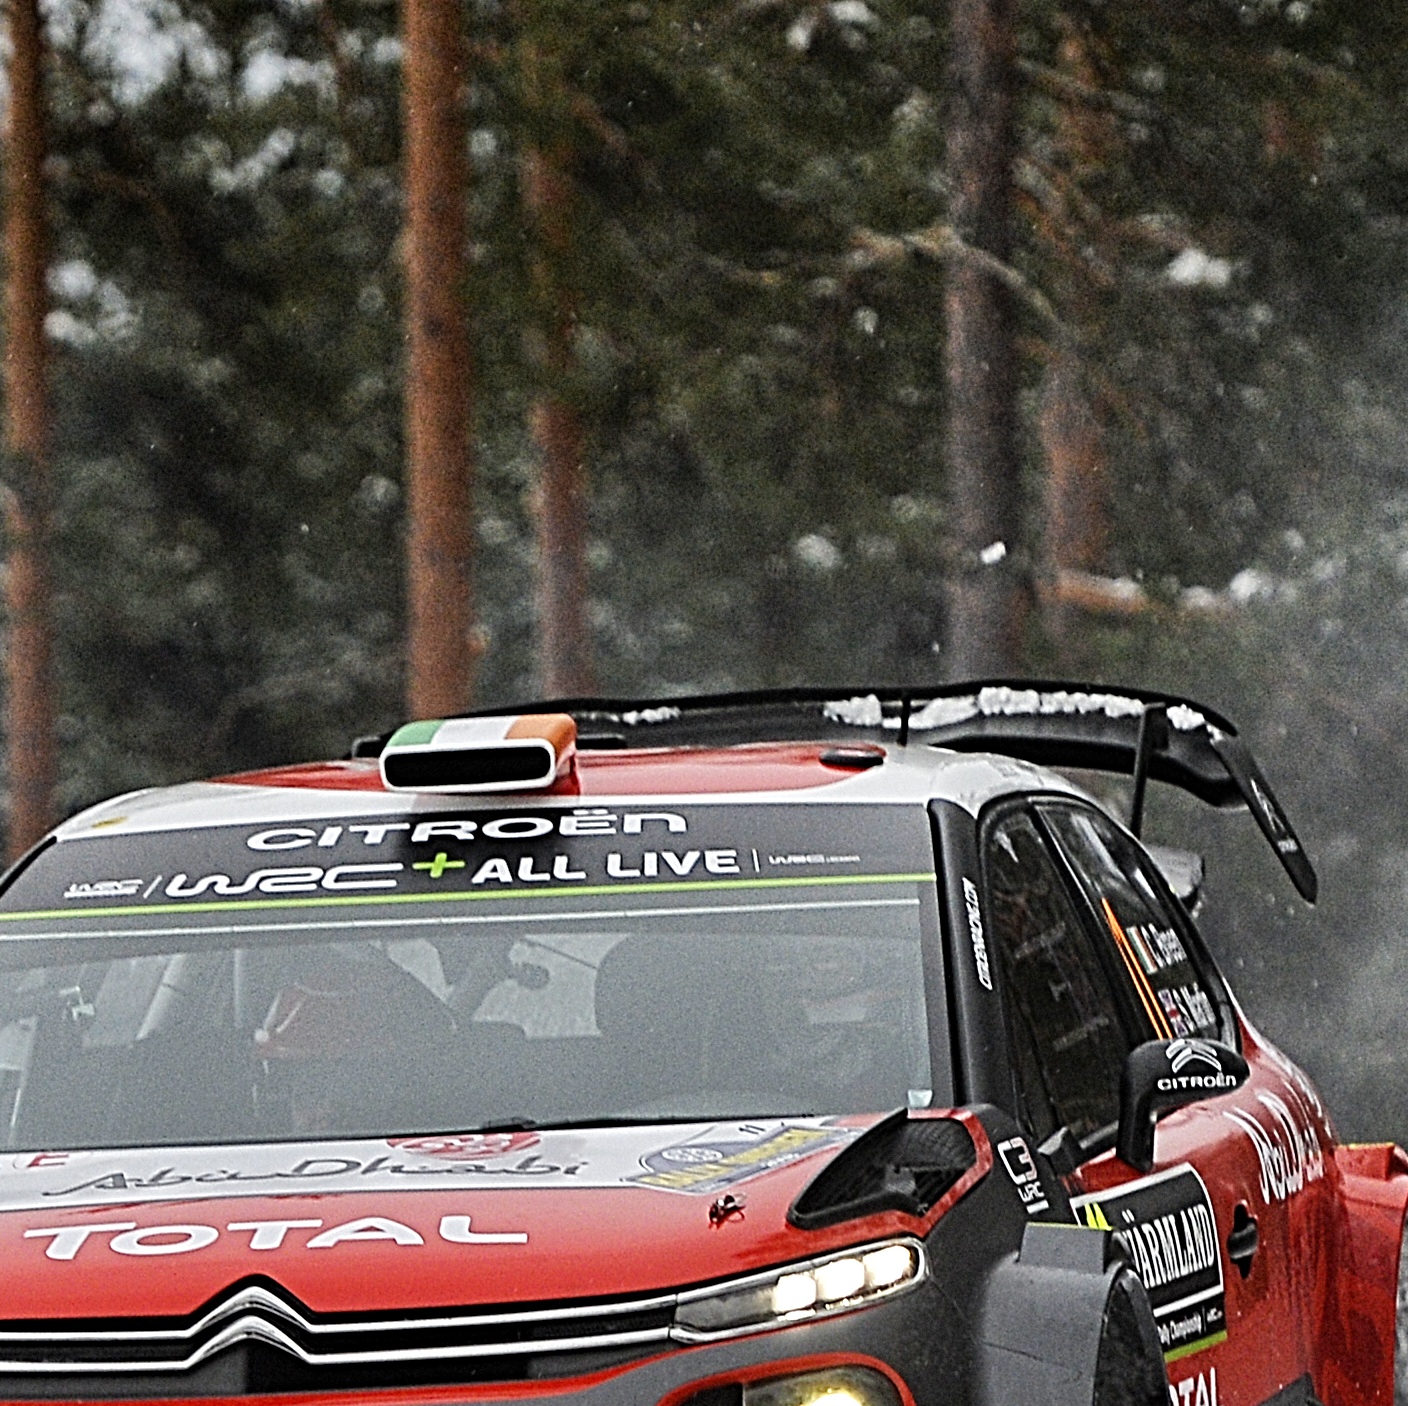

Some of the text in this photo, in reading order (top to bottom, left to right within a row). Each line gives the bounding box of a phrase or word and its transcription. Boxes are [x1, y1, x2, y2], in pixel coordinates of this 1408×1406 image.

[246, 808, 688, 852] CITROËN
[470, 854, 587, 885] ALL
[606, 848, 741, 878] LIVE
[23, 1214, 529, 1261] TOTAL
